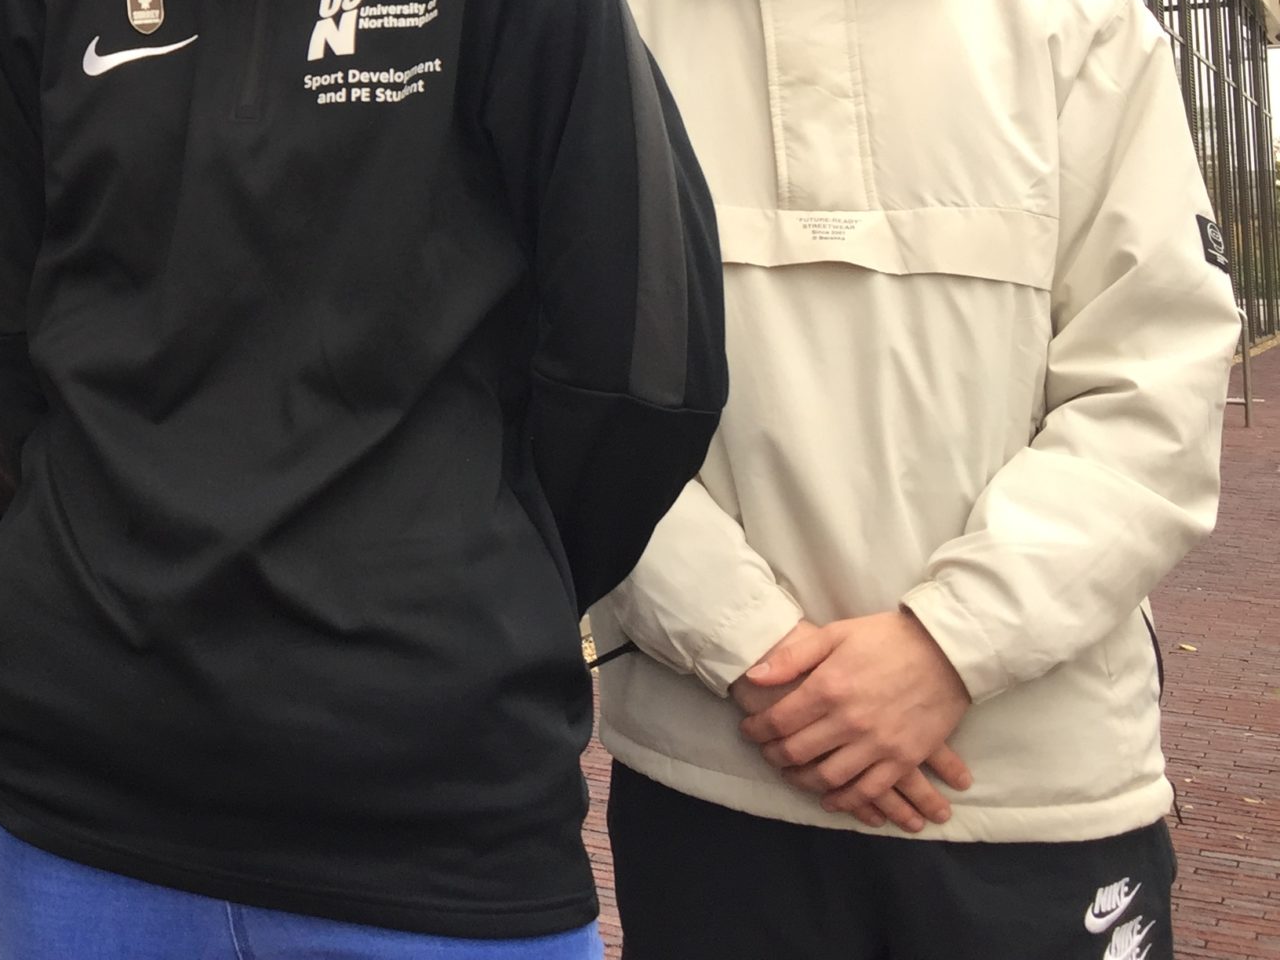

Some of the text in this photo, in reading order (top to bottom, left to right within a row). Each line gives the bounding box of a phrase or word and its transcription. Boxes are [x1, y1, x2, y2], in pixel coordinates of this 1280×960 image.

[358, 9, 439, 29] Northampton
[359, 2, 426, 17] University
[303, 58, 442, 90] Sport Development
[317, 79, 425, 105] and PE Student
[1093, 877, 1130, 914] NIKE
